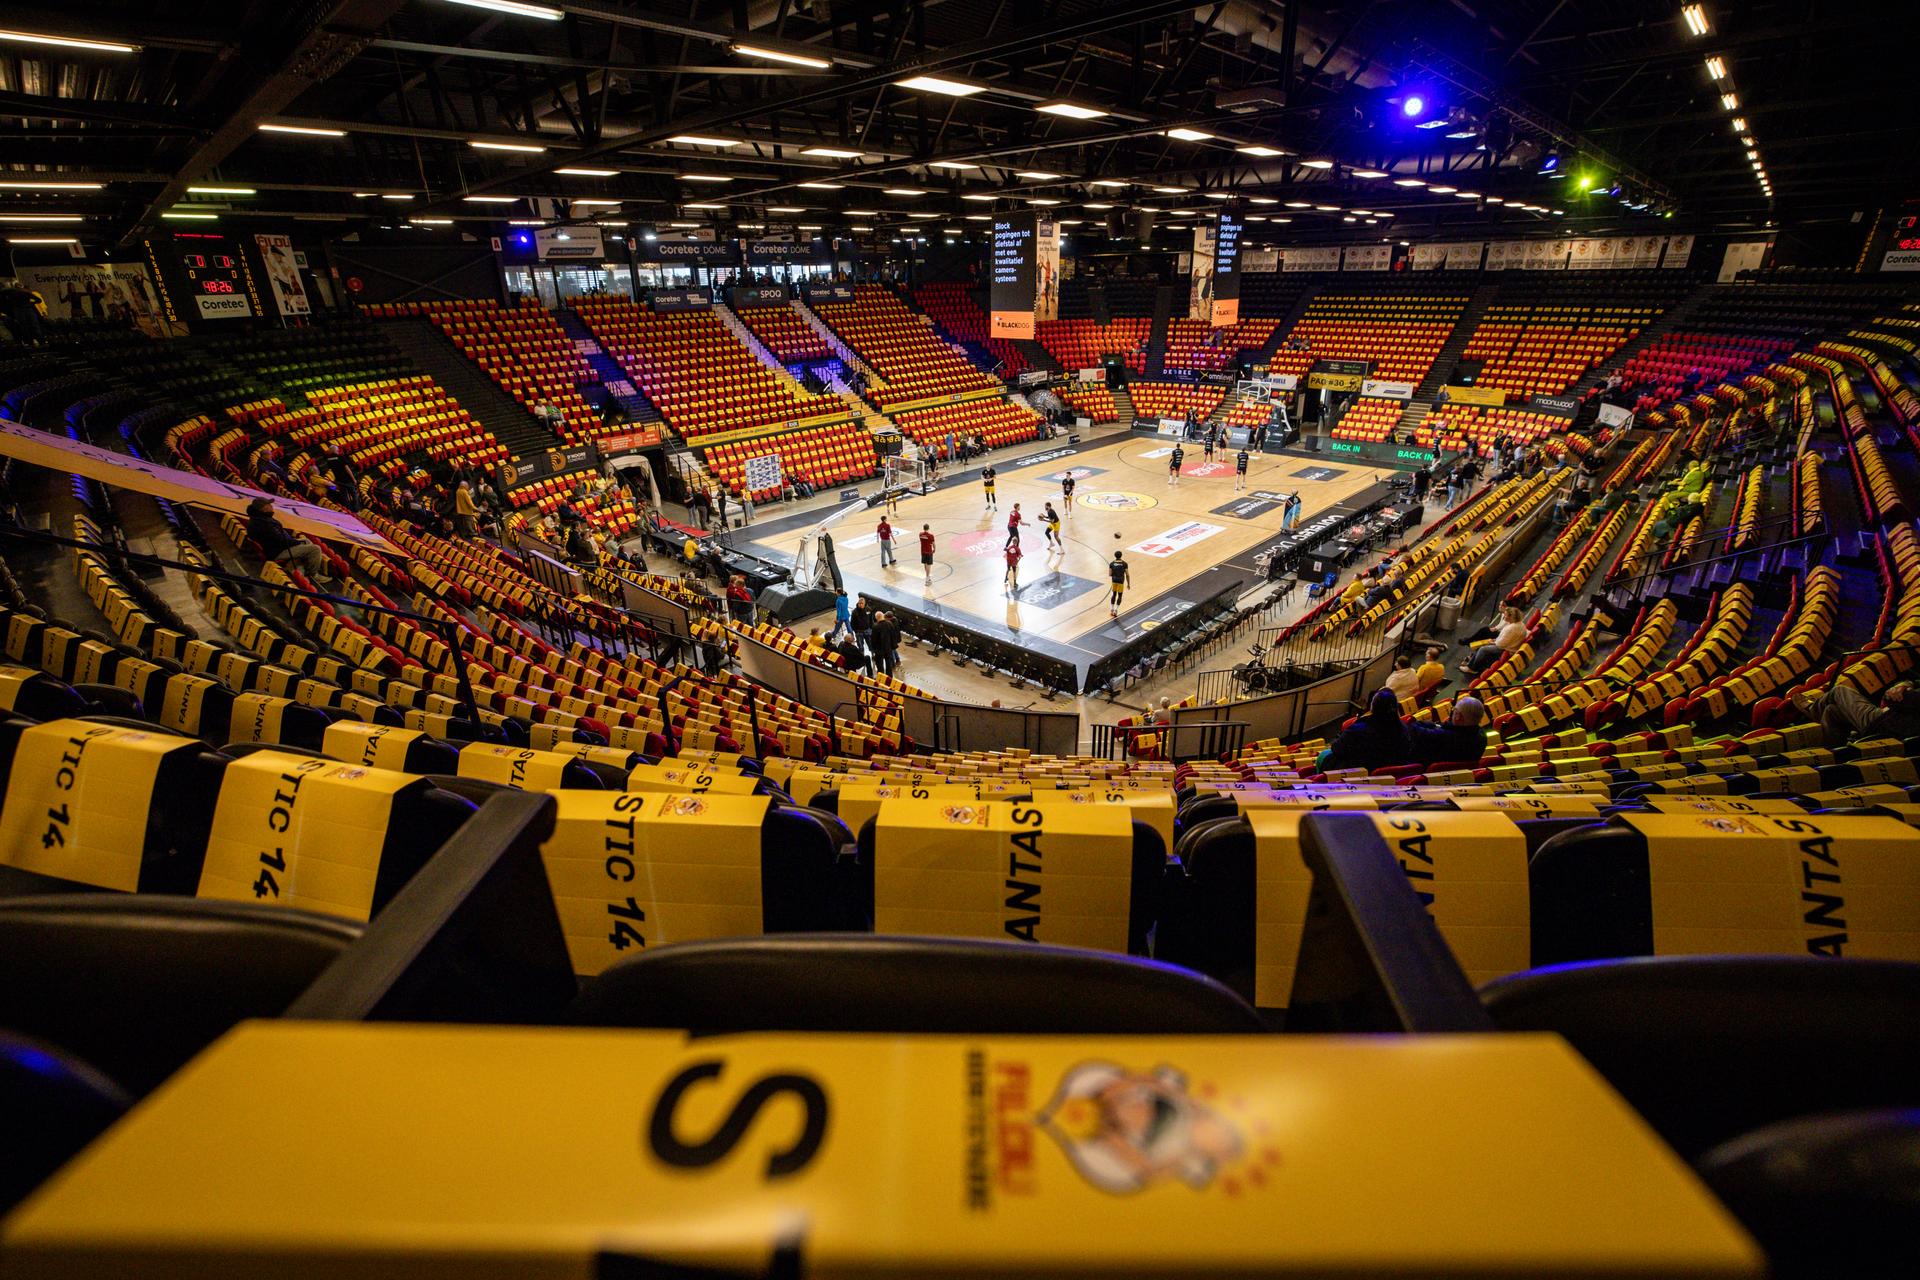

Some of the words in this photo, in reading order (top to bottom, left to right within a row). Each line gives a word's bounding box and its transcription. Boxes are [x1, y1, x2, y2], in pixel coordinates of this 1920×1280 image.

[995, 222, 1010, 230] Block
[1022, 230, 1030, 238] tot
[753, 244, 788, 254] Coretec
[995, 239, 1016, 248] diefstal
[659, 244, 700, 255] Coretec
[194, 255, 205, 268] 0
[222, 255, 231, 268] 0
[995, 257, 1024, 265] kwalitatief
[995, 275, 1018, 284] systeem
[203, 281, 233, 293] 48:26
[655, 295, 681, 304] Coretec
[760, 289, 782, 299] SPOQ
[201, 299, 244, 310] Coretec
[1328, 379, 1345, 387] #30
[1535, 397, 1576, 409] moonwood
[1332, 442, 1351, 452] BACK
[1352, 445, 1361, 453] IN
[1397, 450, 1422, 459] BACK
[1423, 453, 1434, 461] IN
[41, 801, 72, 851] 14
[605, 793, 644, 883] STIC
[252, 846, 288, 900] 14
[1003, 797, 1044, 942] ANTAS
[1773, 818, 1849, 959] ANTAS
[607, 896, 646, 951] 14
